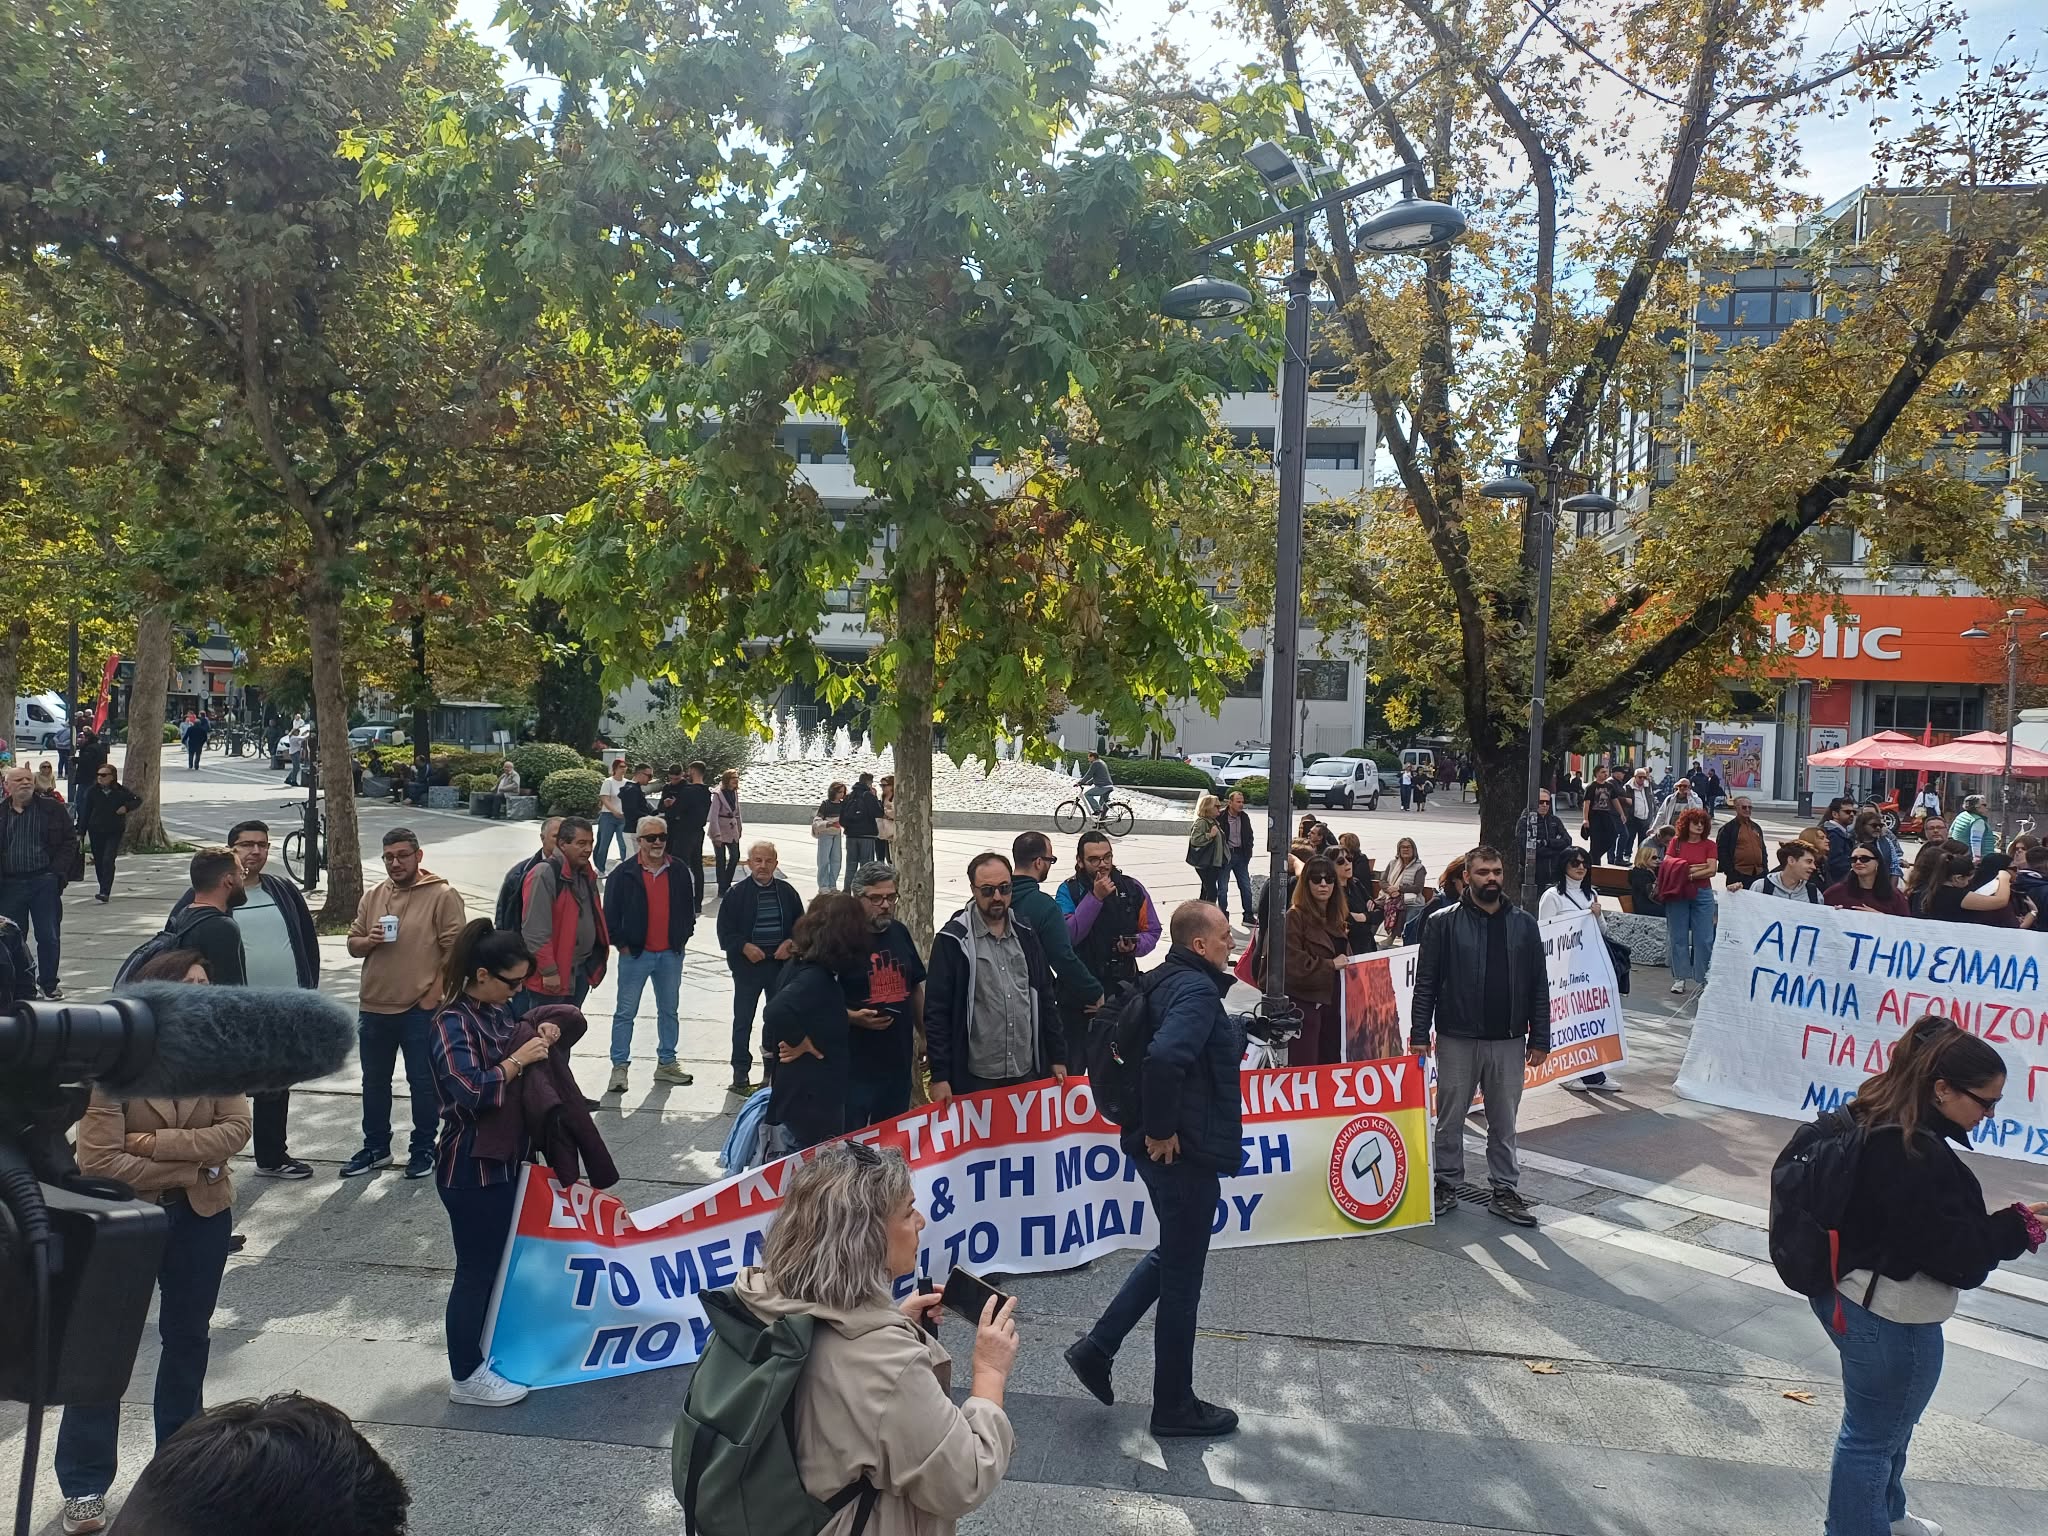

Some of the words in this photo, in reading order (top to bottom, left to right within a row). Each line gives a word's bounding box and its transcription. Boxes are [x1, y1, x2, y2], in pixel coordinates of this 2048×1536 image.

[1754, 920, 1820, 967] ΑΠ
[1570, 985, 1611, 1016] ΠΑΙΔΕΙΑ
[1750, 966, 1860, 1021] ΓΑΛΛΙΑ
[1557, 1018, 1606, 1046] ΣΧΟΛΕΙΟΥ
[1541, 1045, 1599, 1079] ΛΑΡΙΣΑΙΩΝ
[897, 1097, 993, 1161] ΤΗΝ
[1331, 1063, 1407, 1109] ΣΟΥ
[1371, 1118, 1401, 1148] ΚΕΝΤΡΟ
[567, 1256, 641, 1308] ΤΟ
[930, 1176, 956, 1222] &
[966, 1156, 1035, 1203] ΤΗ
[944, 1220, 1000, 1275] ΤΟ
[1020, 1198, 1145, 1257] ΠΑΙΔΙ
